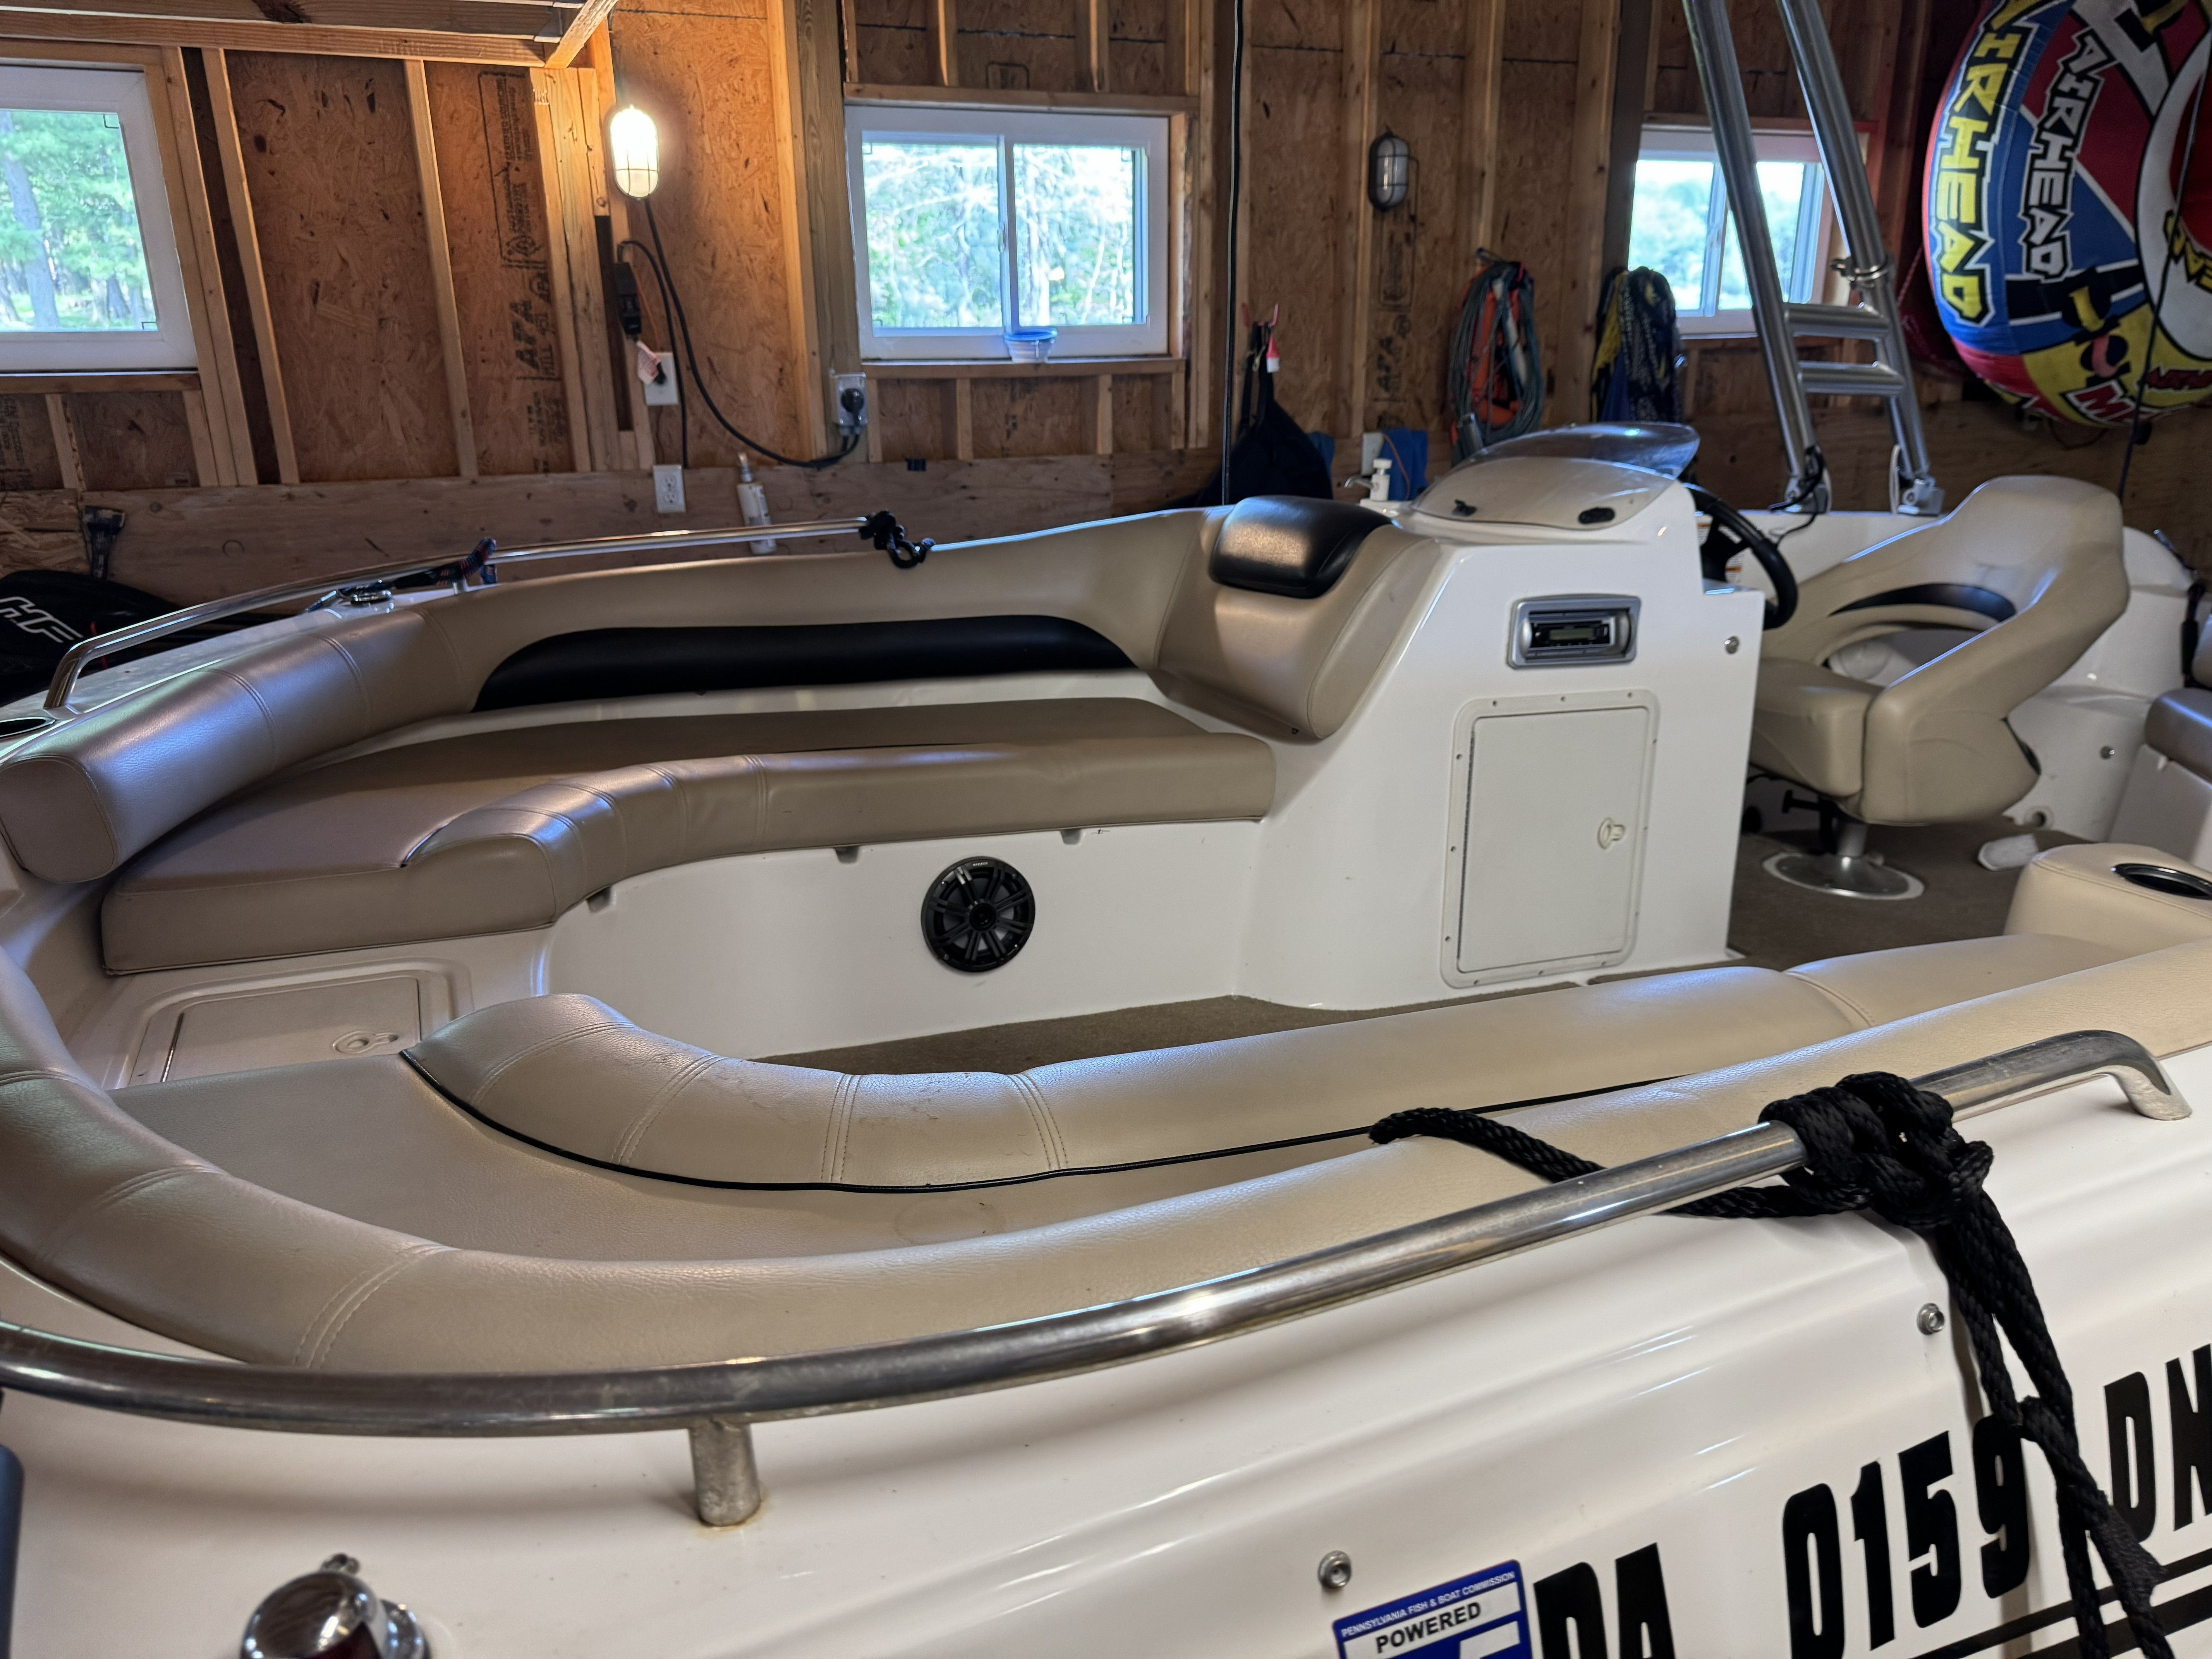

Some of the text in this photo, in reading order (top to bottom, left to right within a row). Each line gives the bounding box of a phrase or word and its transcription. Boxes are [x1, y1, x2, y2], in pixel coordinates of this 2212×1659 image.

[2028, 34, 2110, 276] AIRHEAD
[1782, 1413, 2031, 1659] 0159
[2103, 1343, 2212, 1543] DN
[1341, 1571, 1515, 1637] PENNSYLVANIA FISH & BOAT COMMISSION
[1376, 1602, 1481, 1654] POWERED
